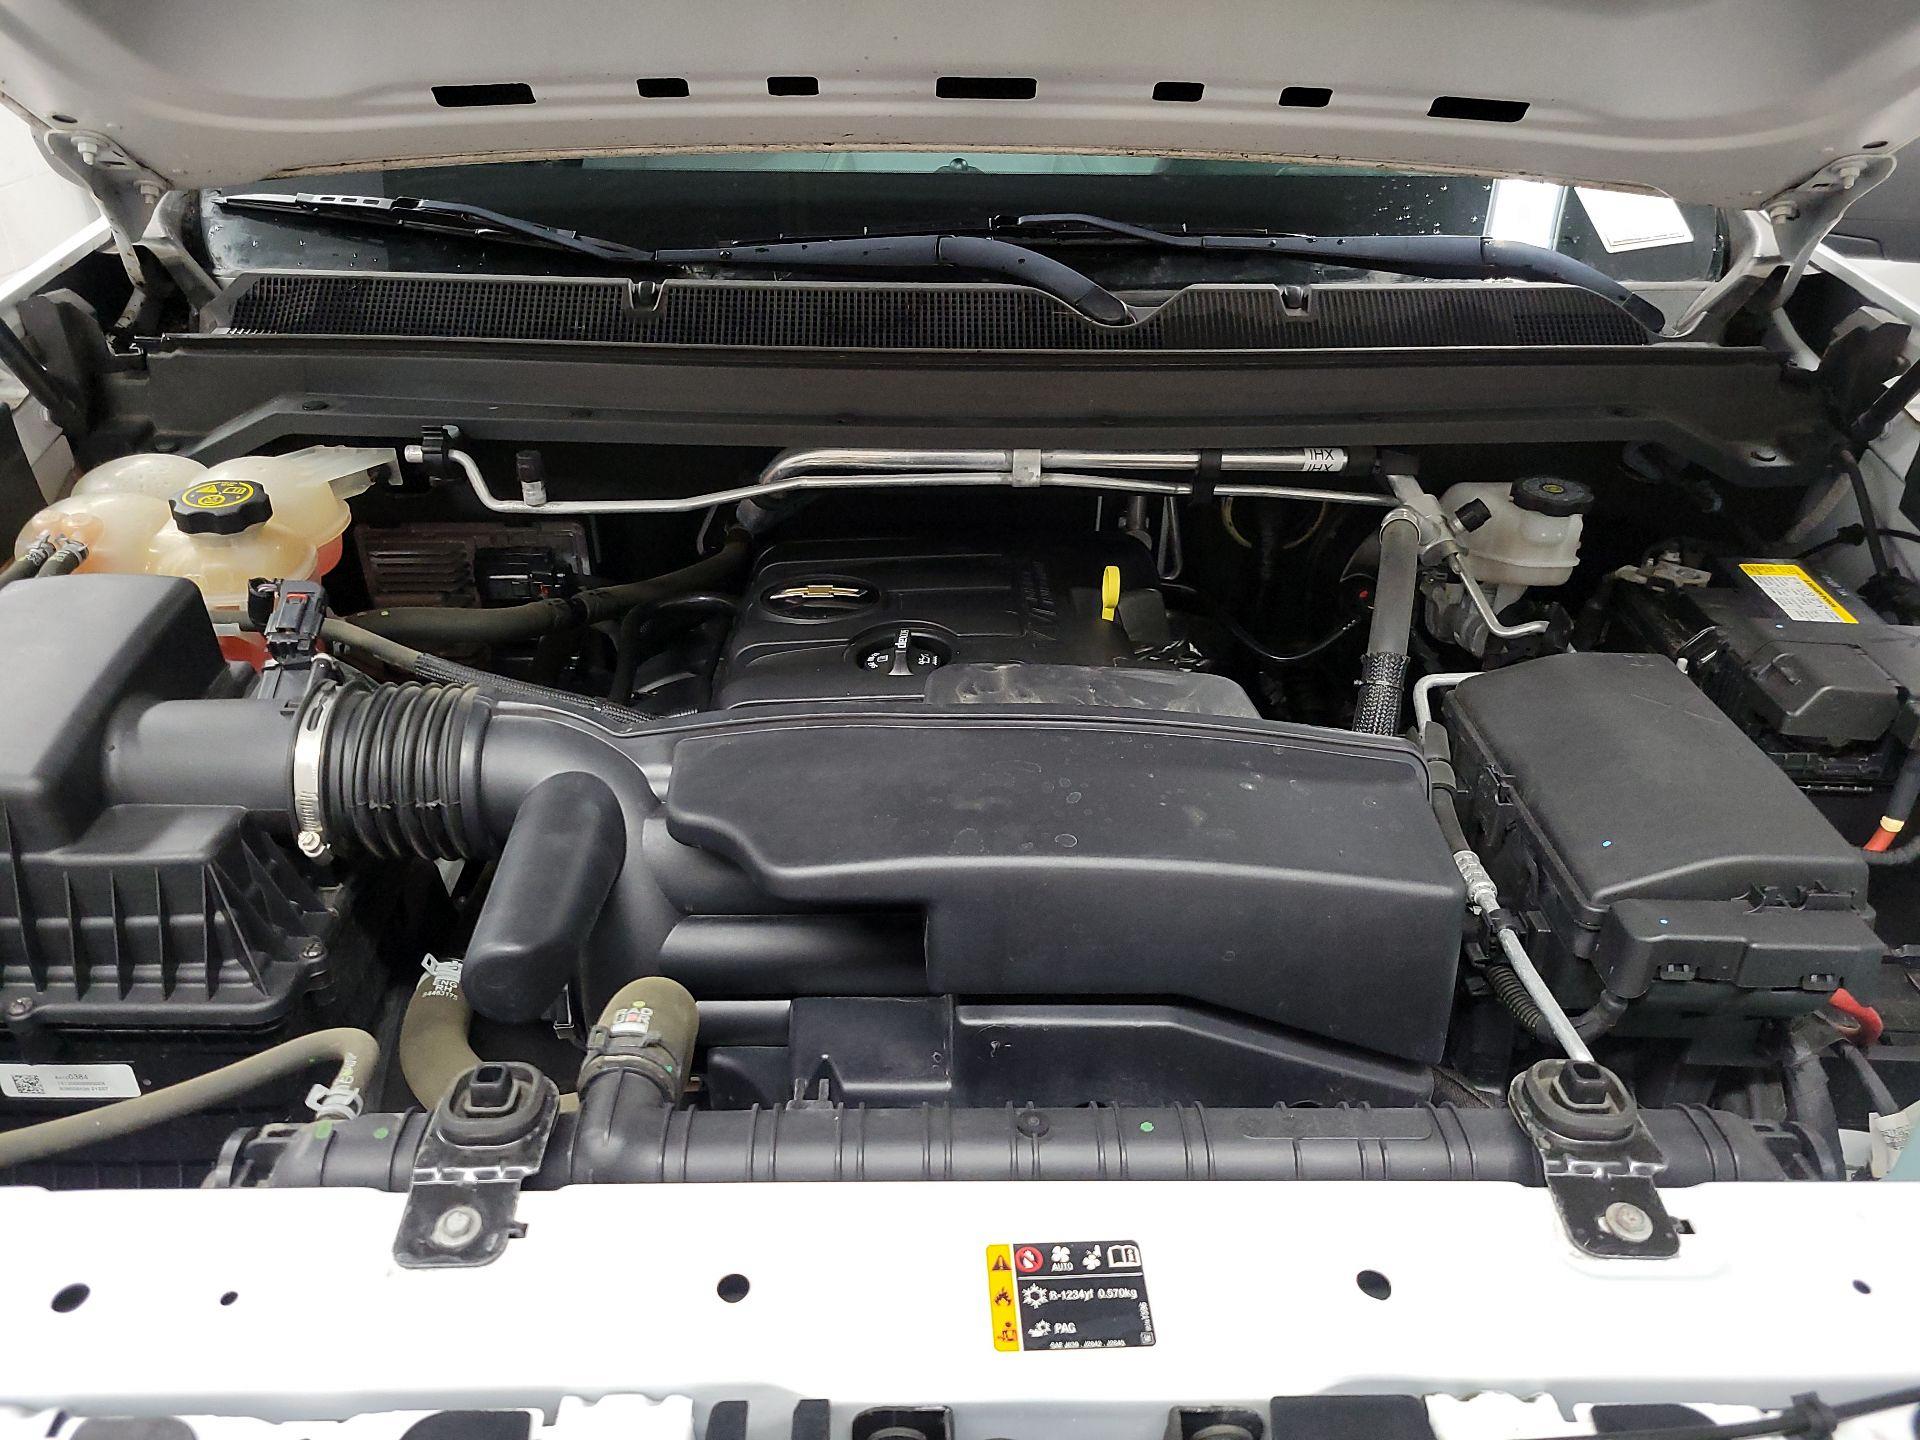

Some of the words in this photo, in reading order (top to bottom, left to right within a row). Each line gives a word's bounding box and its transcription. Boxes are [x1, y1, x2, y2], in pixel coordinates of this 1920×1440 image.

[1310, 449, 1334, 460] IHX
[1051, 1262, 1074, 1272] AUTO
[1049, 1288, 1094, 1302] R-1234yf
[1098, 1288, 1138, 1300] 0.570kg
[1054, 1322, 1077, 1334] PAG
